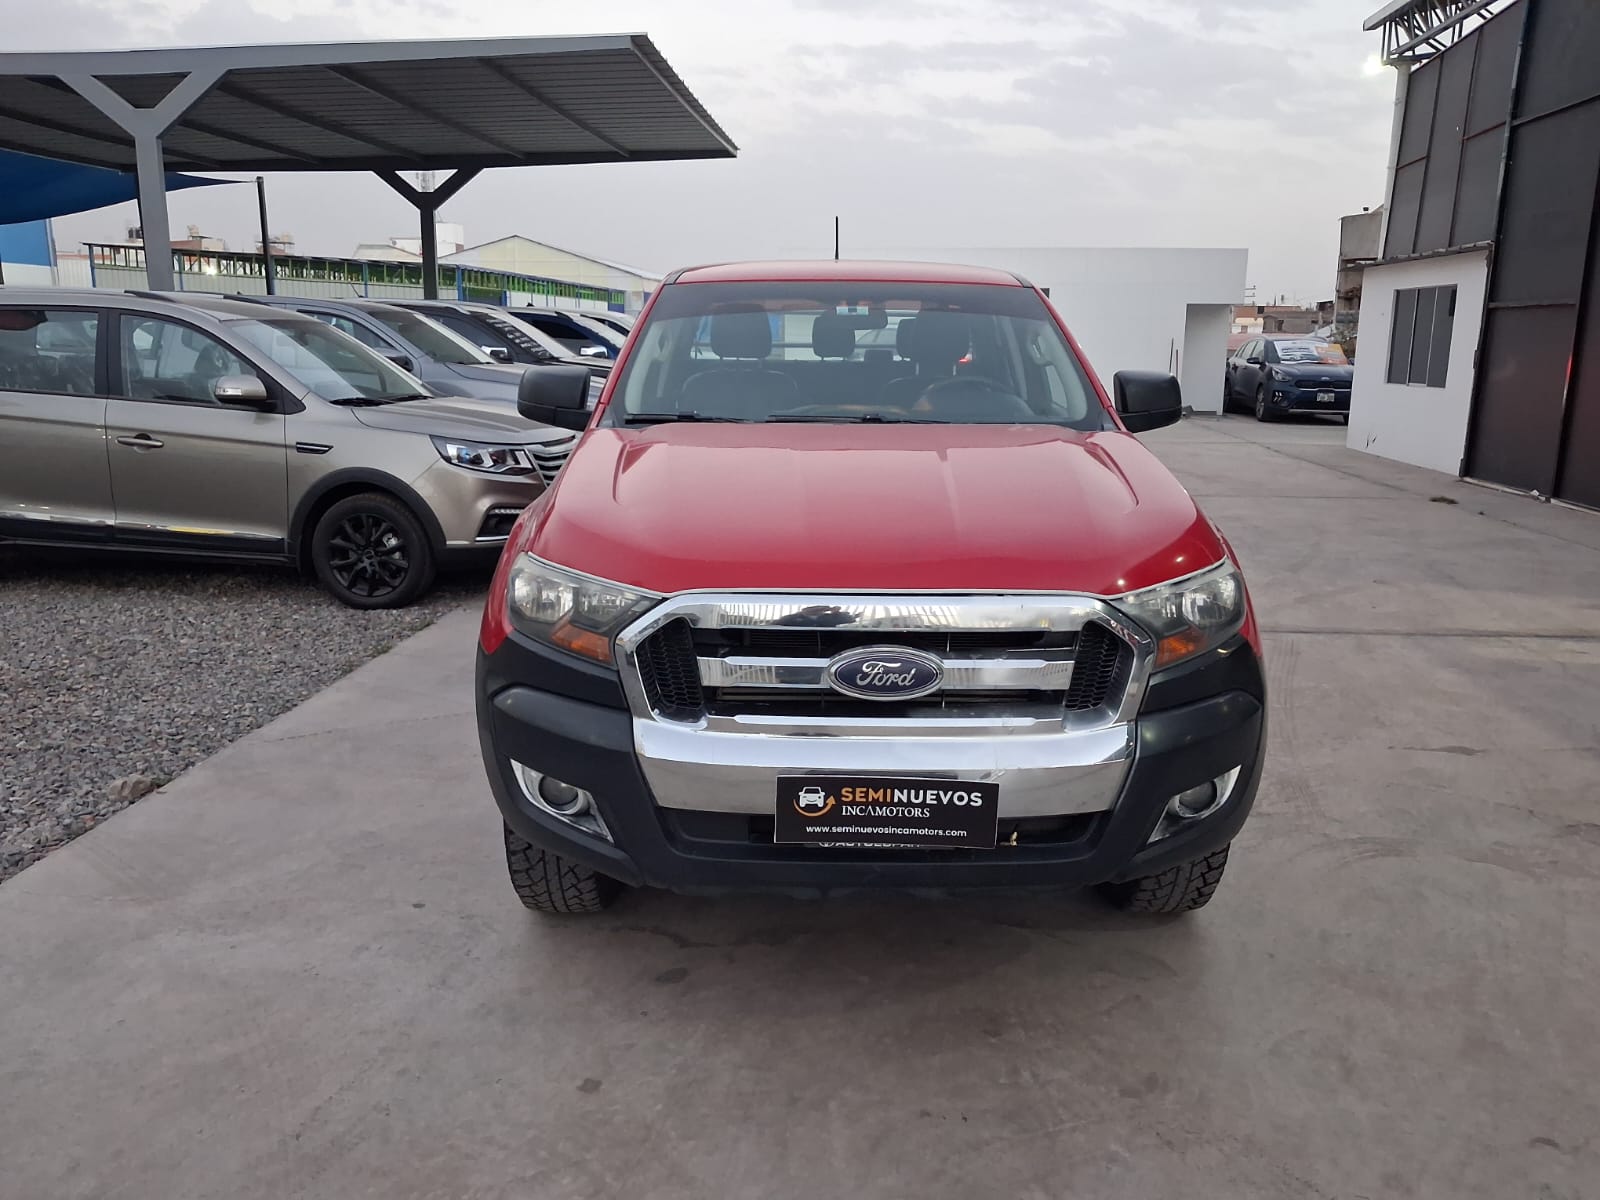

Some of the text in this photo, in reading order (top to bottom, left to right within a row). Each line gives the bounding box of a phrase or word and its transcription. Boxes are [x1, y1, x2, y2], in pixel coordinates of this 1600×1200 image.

[856, 660, 916, 687] Ford
[841, 787, 983, 807] SEMINUEVOS
[842, 805, 930, 818] INCAMOTORS
[805, 824, 967, 837] www.seminuevosincamotors.com
